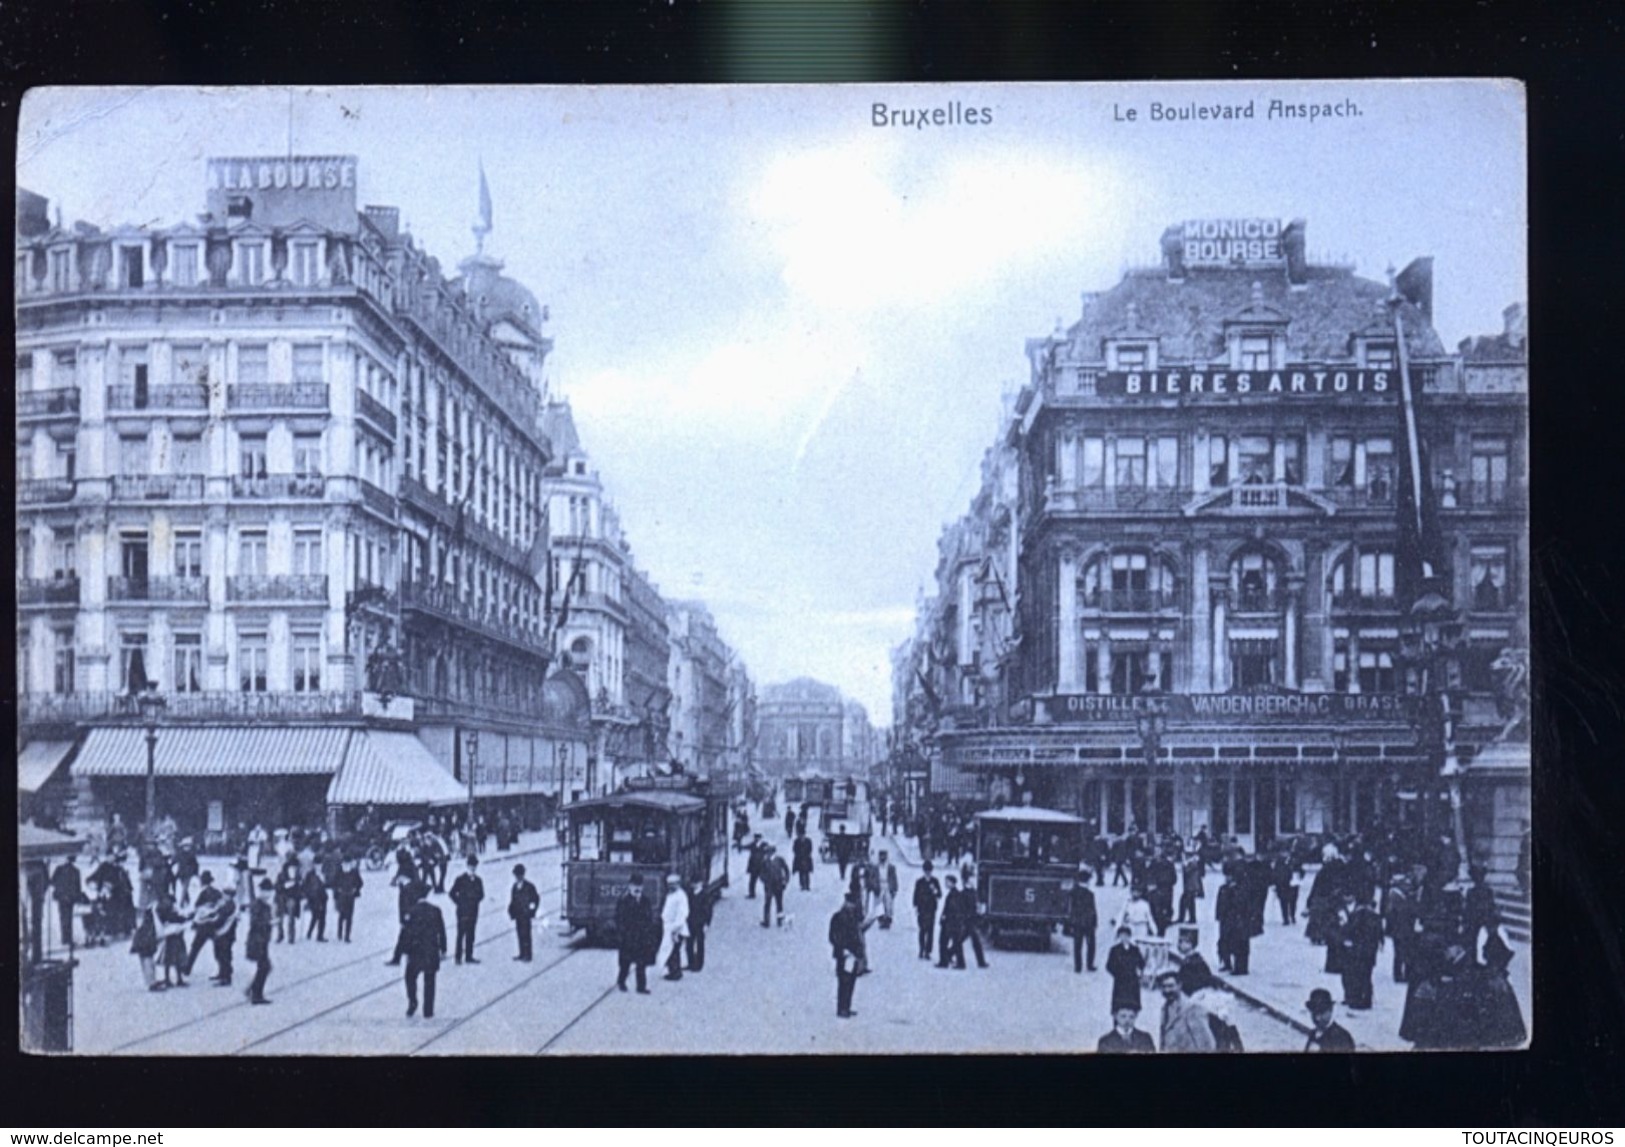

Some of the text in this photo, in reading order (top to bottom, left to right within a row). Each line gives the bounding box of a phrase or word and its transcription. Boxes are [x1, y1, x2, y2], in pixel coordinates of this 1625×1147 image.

[258, 162, 356, 190] BOURSE
[1184, 219, 1280, 239] MONICO
[1184, 239, 1280, 260] BOURSE
[1268, 372, 1388, 392] ARTOIS
